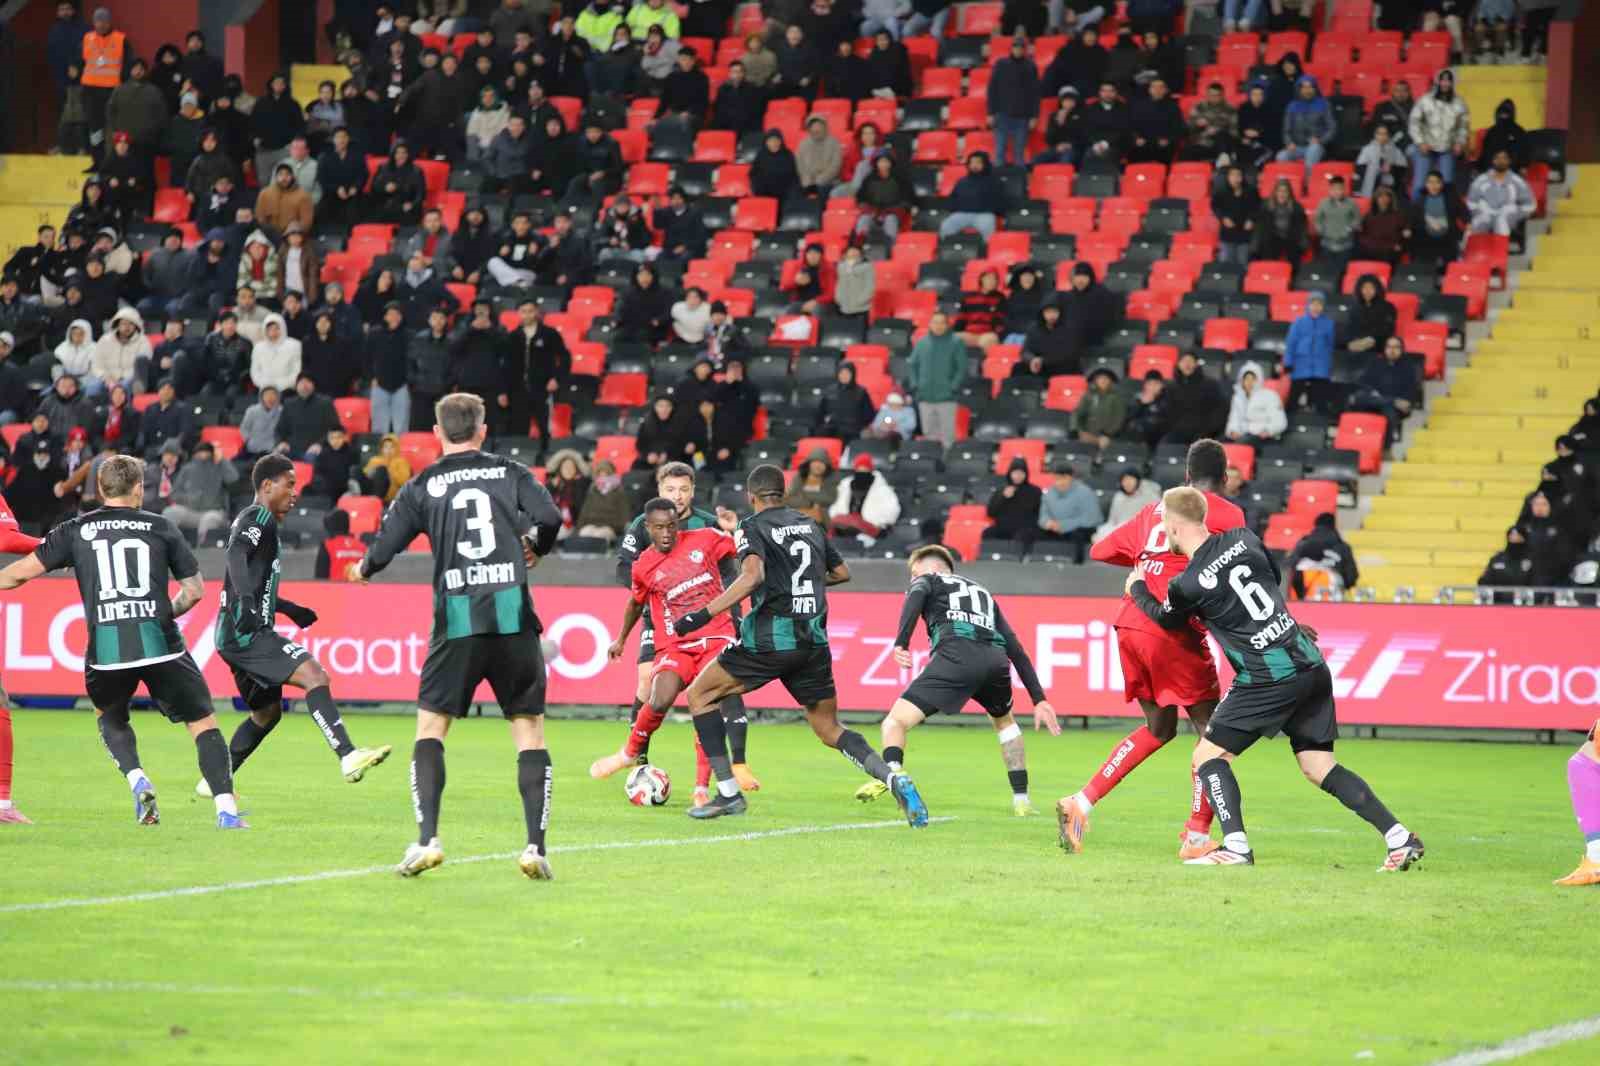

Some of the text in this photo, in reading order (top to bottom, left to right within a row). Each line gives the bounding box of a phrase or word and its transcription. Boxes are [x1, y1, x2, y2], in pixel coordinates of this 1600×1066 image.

[429, 466, 507, 490] AUTOPORT
[86, 520, 153, 534] AUTOPORT
[452, 488, 496, 559] 3
[92, 538, 151, 600] 10
[789, 540, 814, 595] 2
[1203, 540, 1248, 582] AUTOPORT
[1228, 565, 1275, 621] 6
[1207, 772, 1232, 823] SPORTRUN
